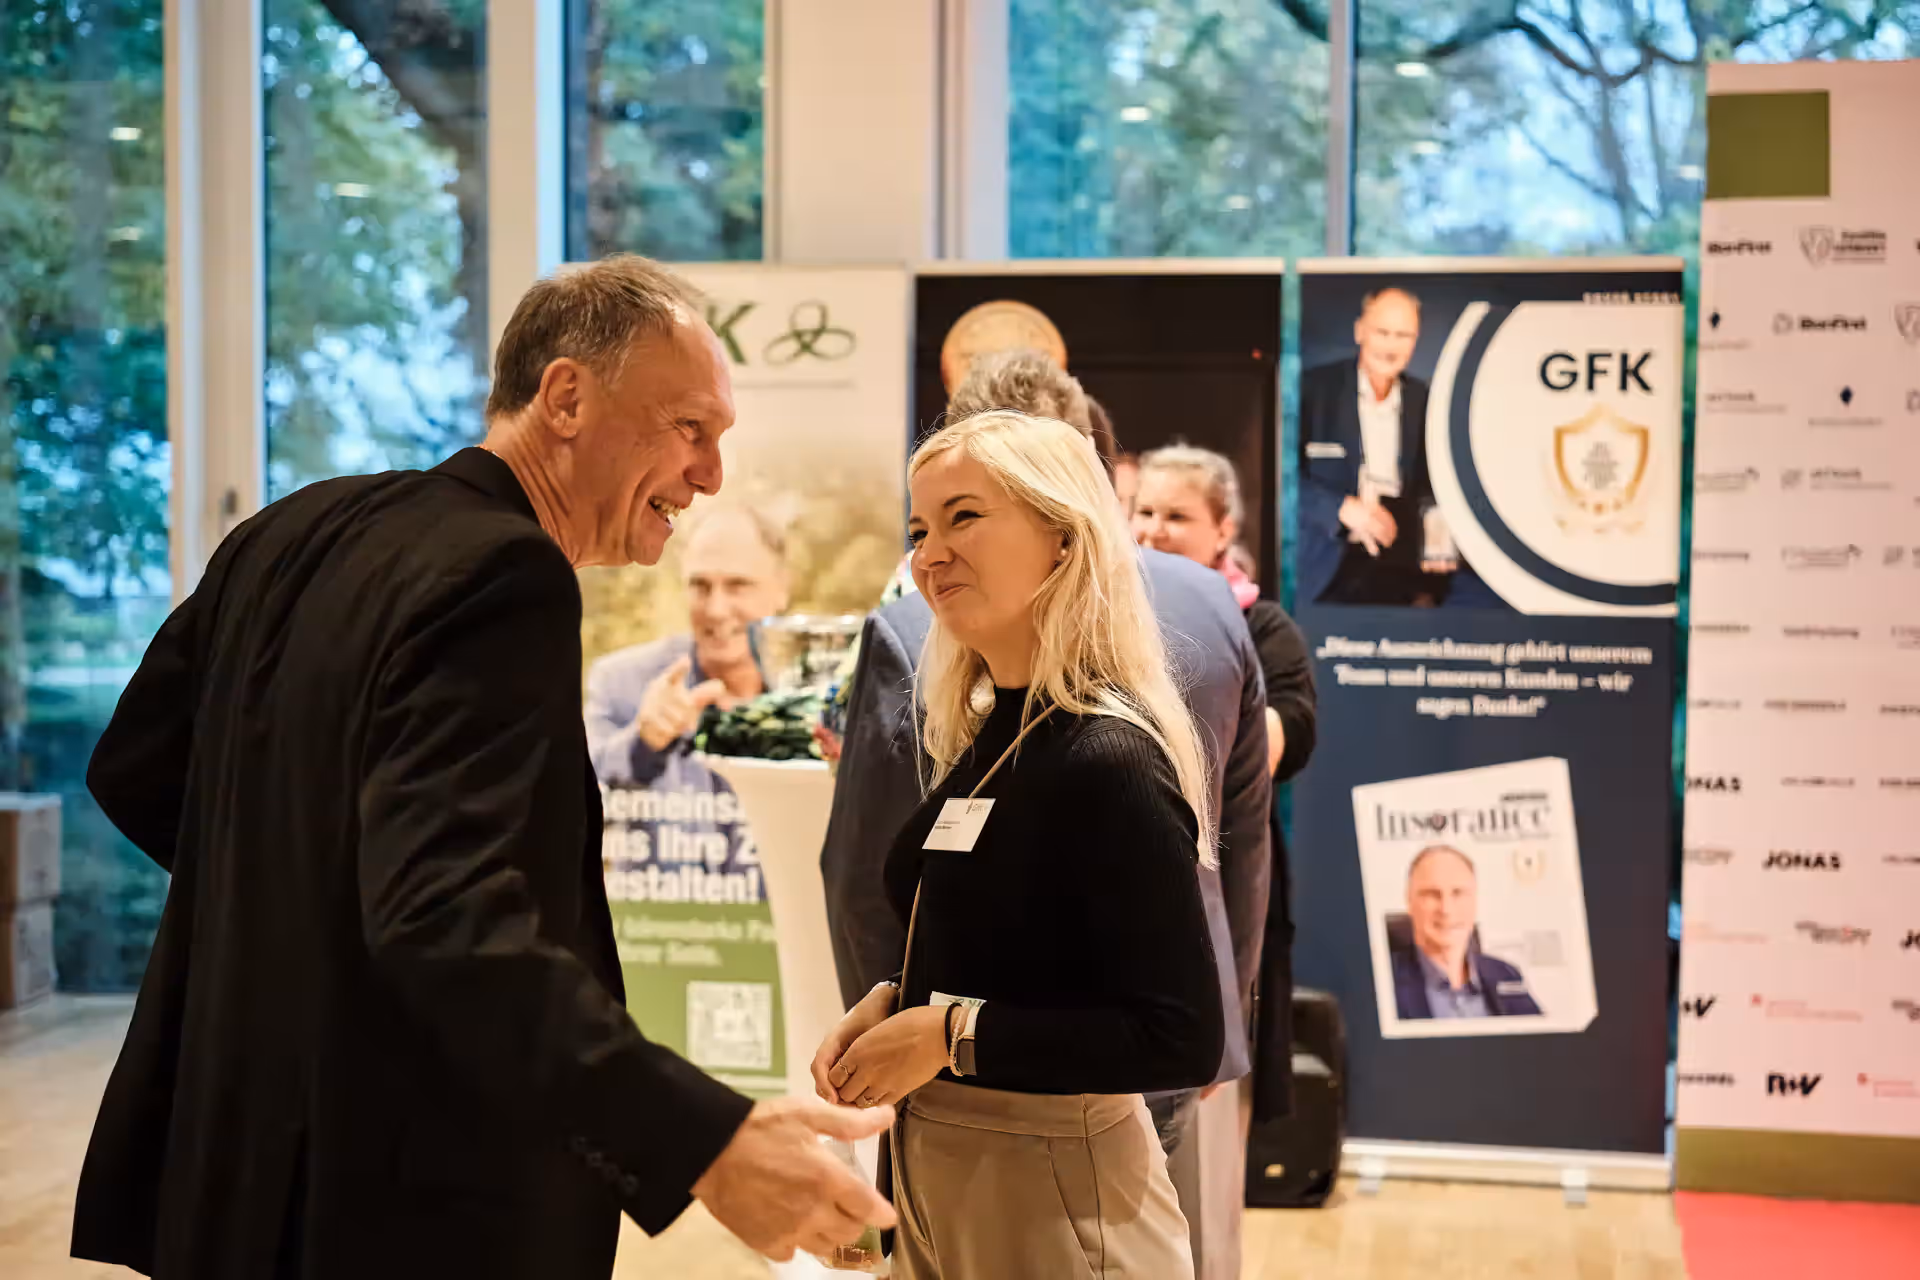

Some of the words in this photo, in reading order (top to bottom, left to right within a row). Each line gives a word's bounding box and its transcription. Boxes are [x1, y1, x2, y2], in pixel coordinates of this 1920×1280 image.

[1540, 352, 1653, 393] GFK
[657, 825, 729, 864] Ihre
[1762, 851, 1842, 871] JONAS
[604, 864, 760, 904] estalten!
